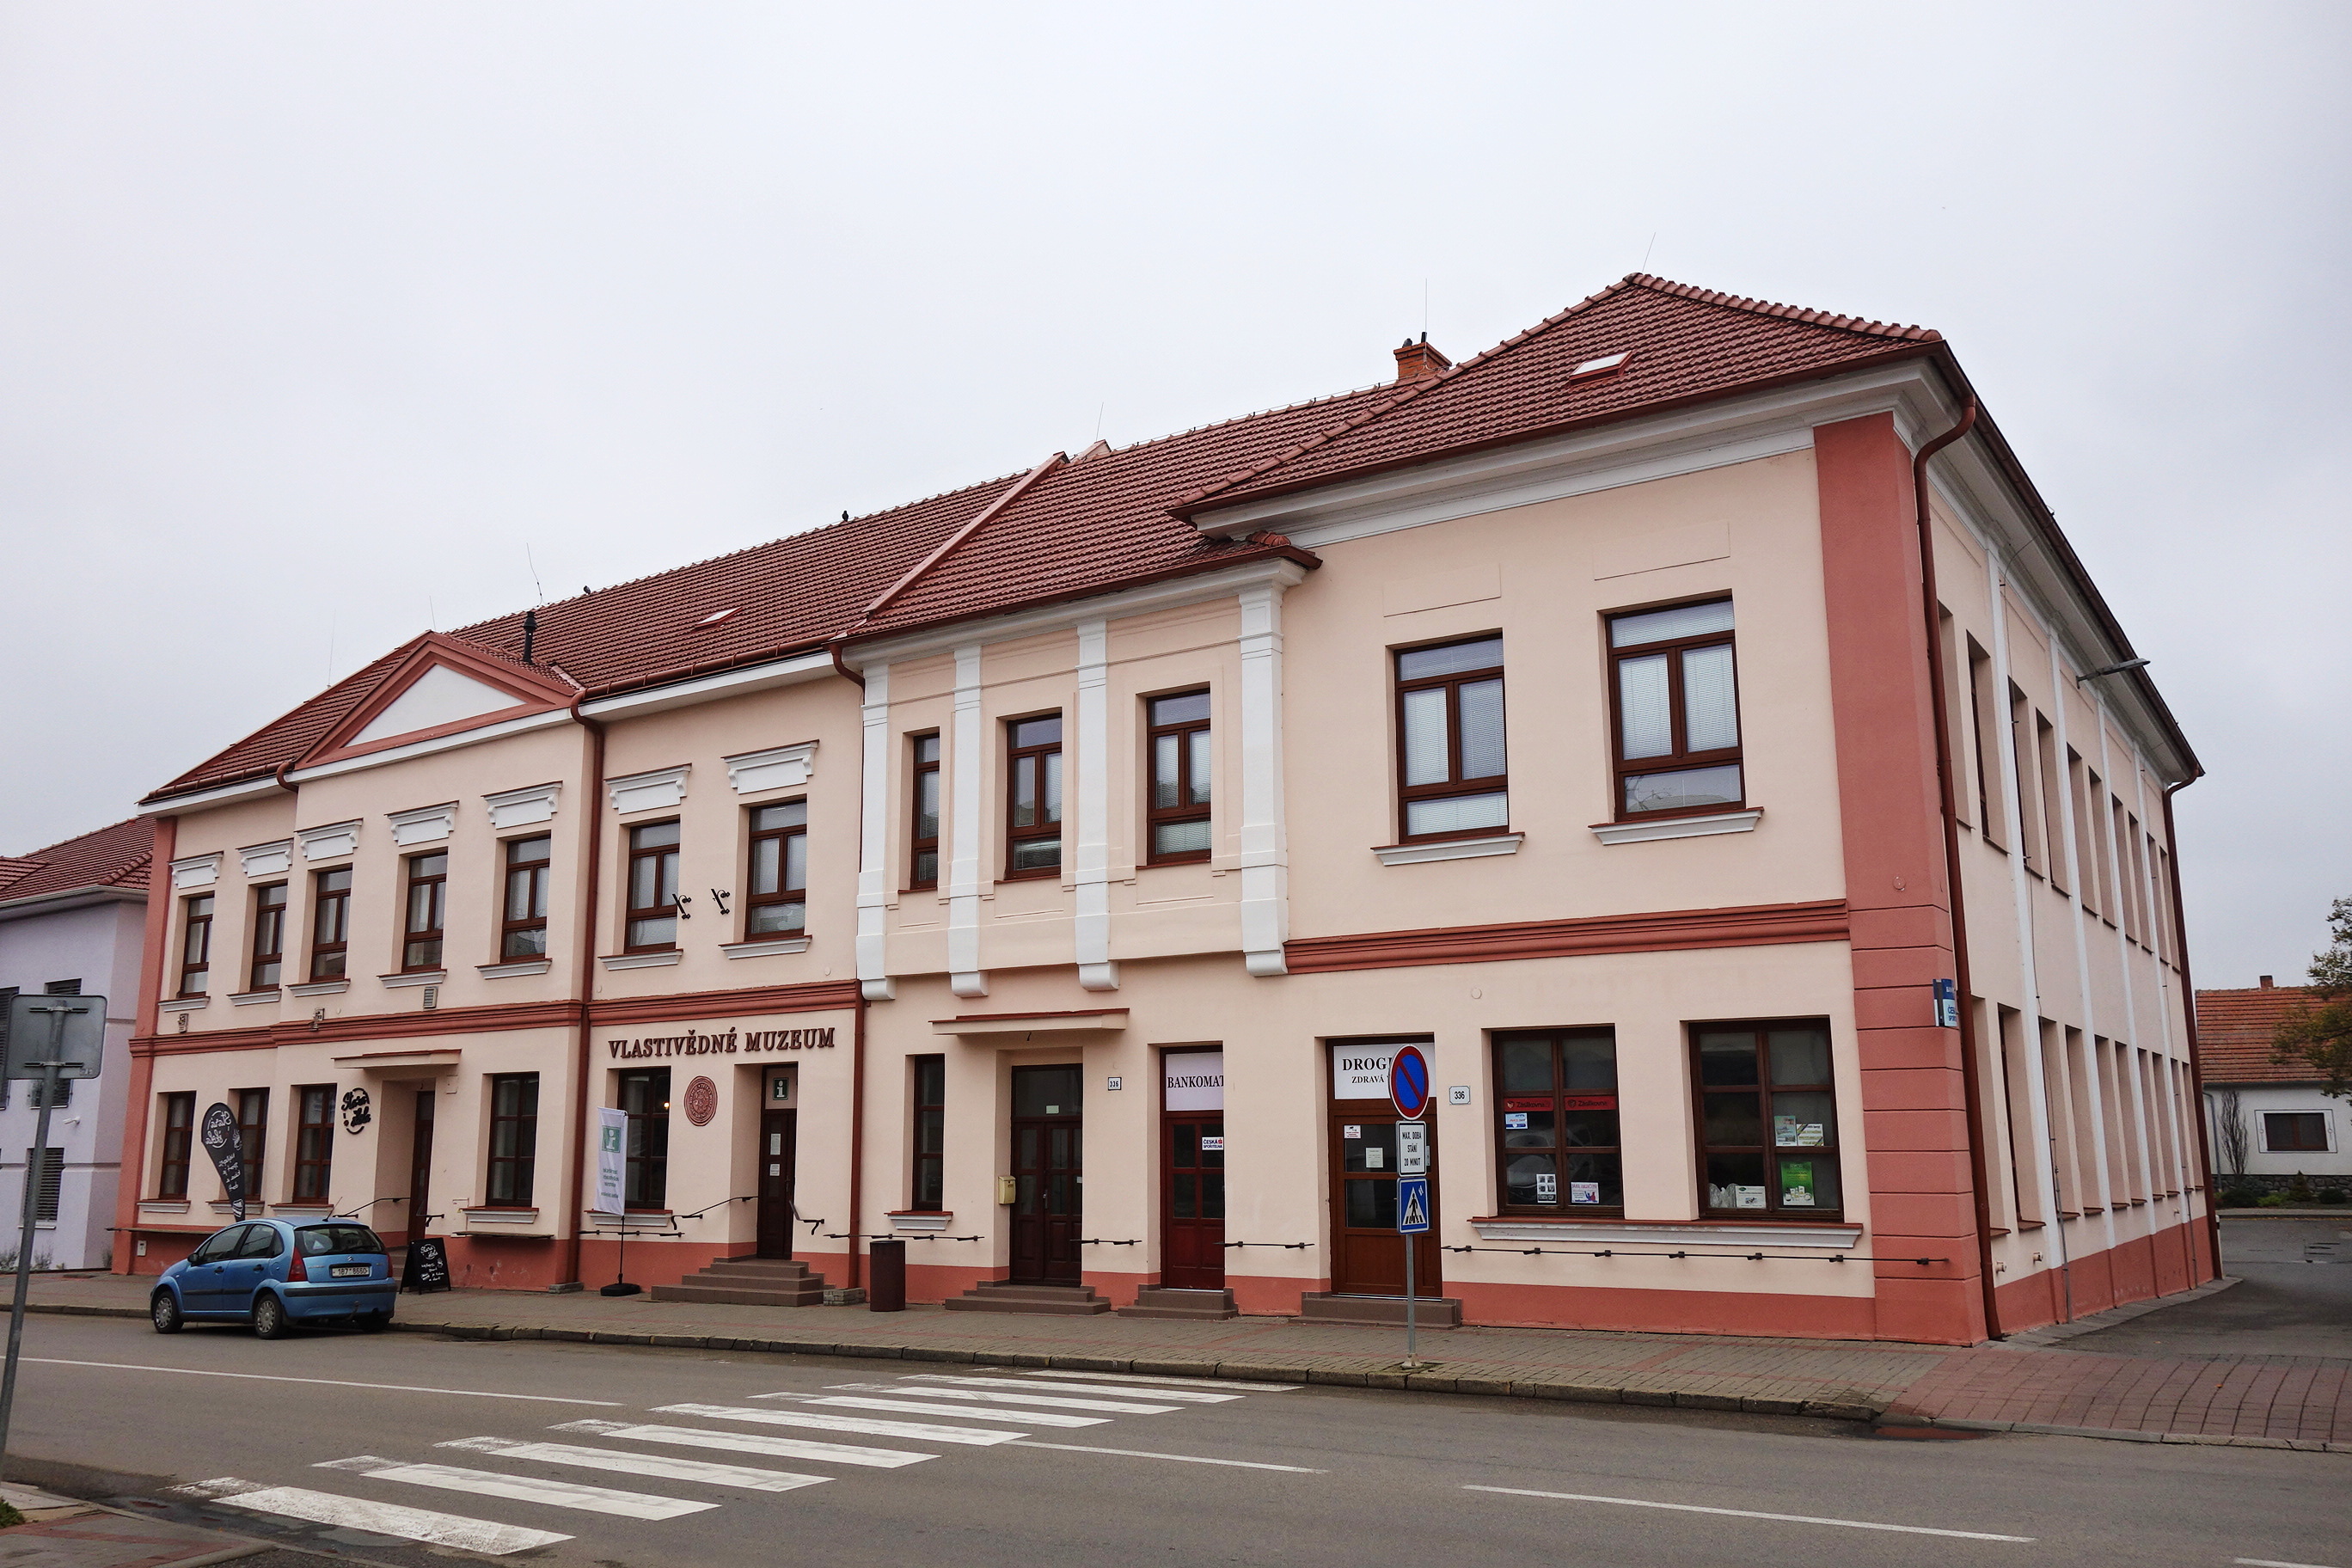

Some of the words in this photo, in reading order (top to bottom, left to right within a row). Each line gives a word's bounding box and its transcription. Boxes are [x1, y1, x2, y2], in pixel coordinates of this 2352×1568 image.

[609, 1027, 738, 1058] VLASTIVĚDNÉ
[744, 1027, 836, 1052] MUZEUM
[1343, 1057, 1392, 1071] DROG
[1351, 1075, 1385, 1084] ZDRAVÁ
[1454, 1091, 1465, 1099] 336
[1402, 1131, 1412, 1140] MAX.
[1412, 1131, 1422, 1140] DOBA
[1407, 1143, 1418, 1153] STÁNÍ
[1404, 1158, 1410, 1167] 20
[1410, 1158, 1421, 1167] MINUT
